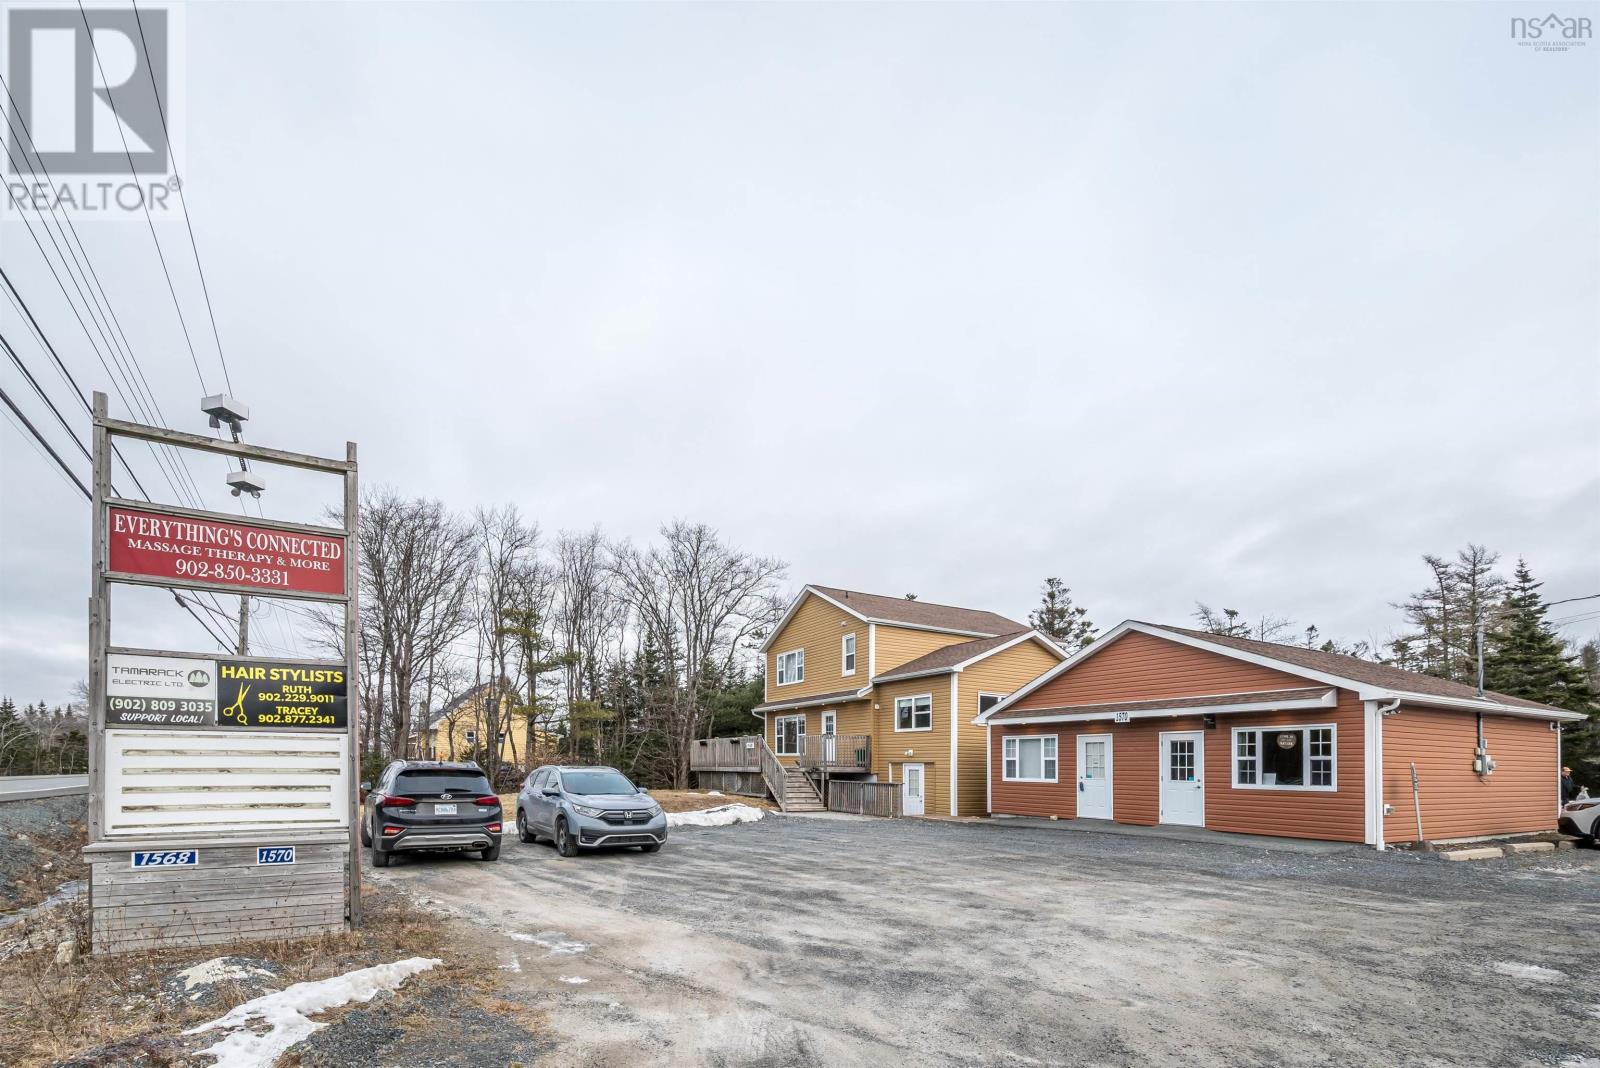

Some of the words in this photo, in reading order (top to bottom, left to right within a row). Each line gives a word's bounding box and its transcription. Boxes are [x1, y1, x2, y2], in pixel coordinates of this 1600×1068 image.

[114, 513, 243, 548] EVERYTHING'S
[246, 531, 341, 560] CONNECTED
[127, 538, 202, 556] MASSAGE
[205, 547, 274, 564] THERAPY
[276, 556, 286, 566] &
[289, 558, 331, 571] MORE
[175, 558, 290, 586] 902-850-3331
[112, 666, 184, 678] TAMARACK
[221, 665, 266, 680] HAIR
[269, 668, 344, 683] STYLISTS
[112, 678, 162, 686] ELECTRIC
[282, 685, 312, 693] RUTH
[258, 692, 335, 704] 902.229.9011
[109, 697, 146, 712] (902)
[150, 700, 176, 711] 809
[180, 701, 213, 713] 3035
[276, 706, 319, 716] TRACEY
[120, 712, 168, 723] SUPPORT
[170, 714, 204, 724] LOCAL!
[258, 714, 336, 725] 902.877.2341
[139, 852, 191, 866] 1568
[260, 849, 293, 863] 1570
